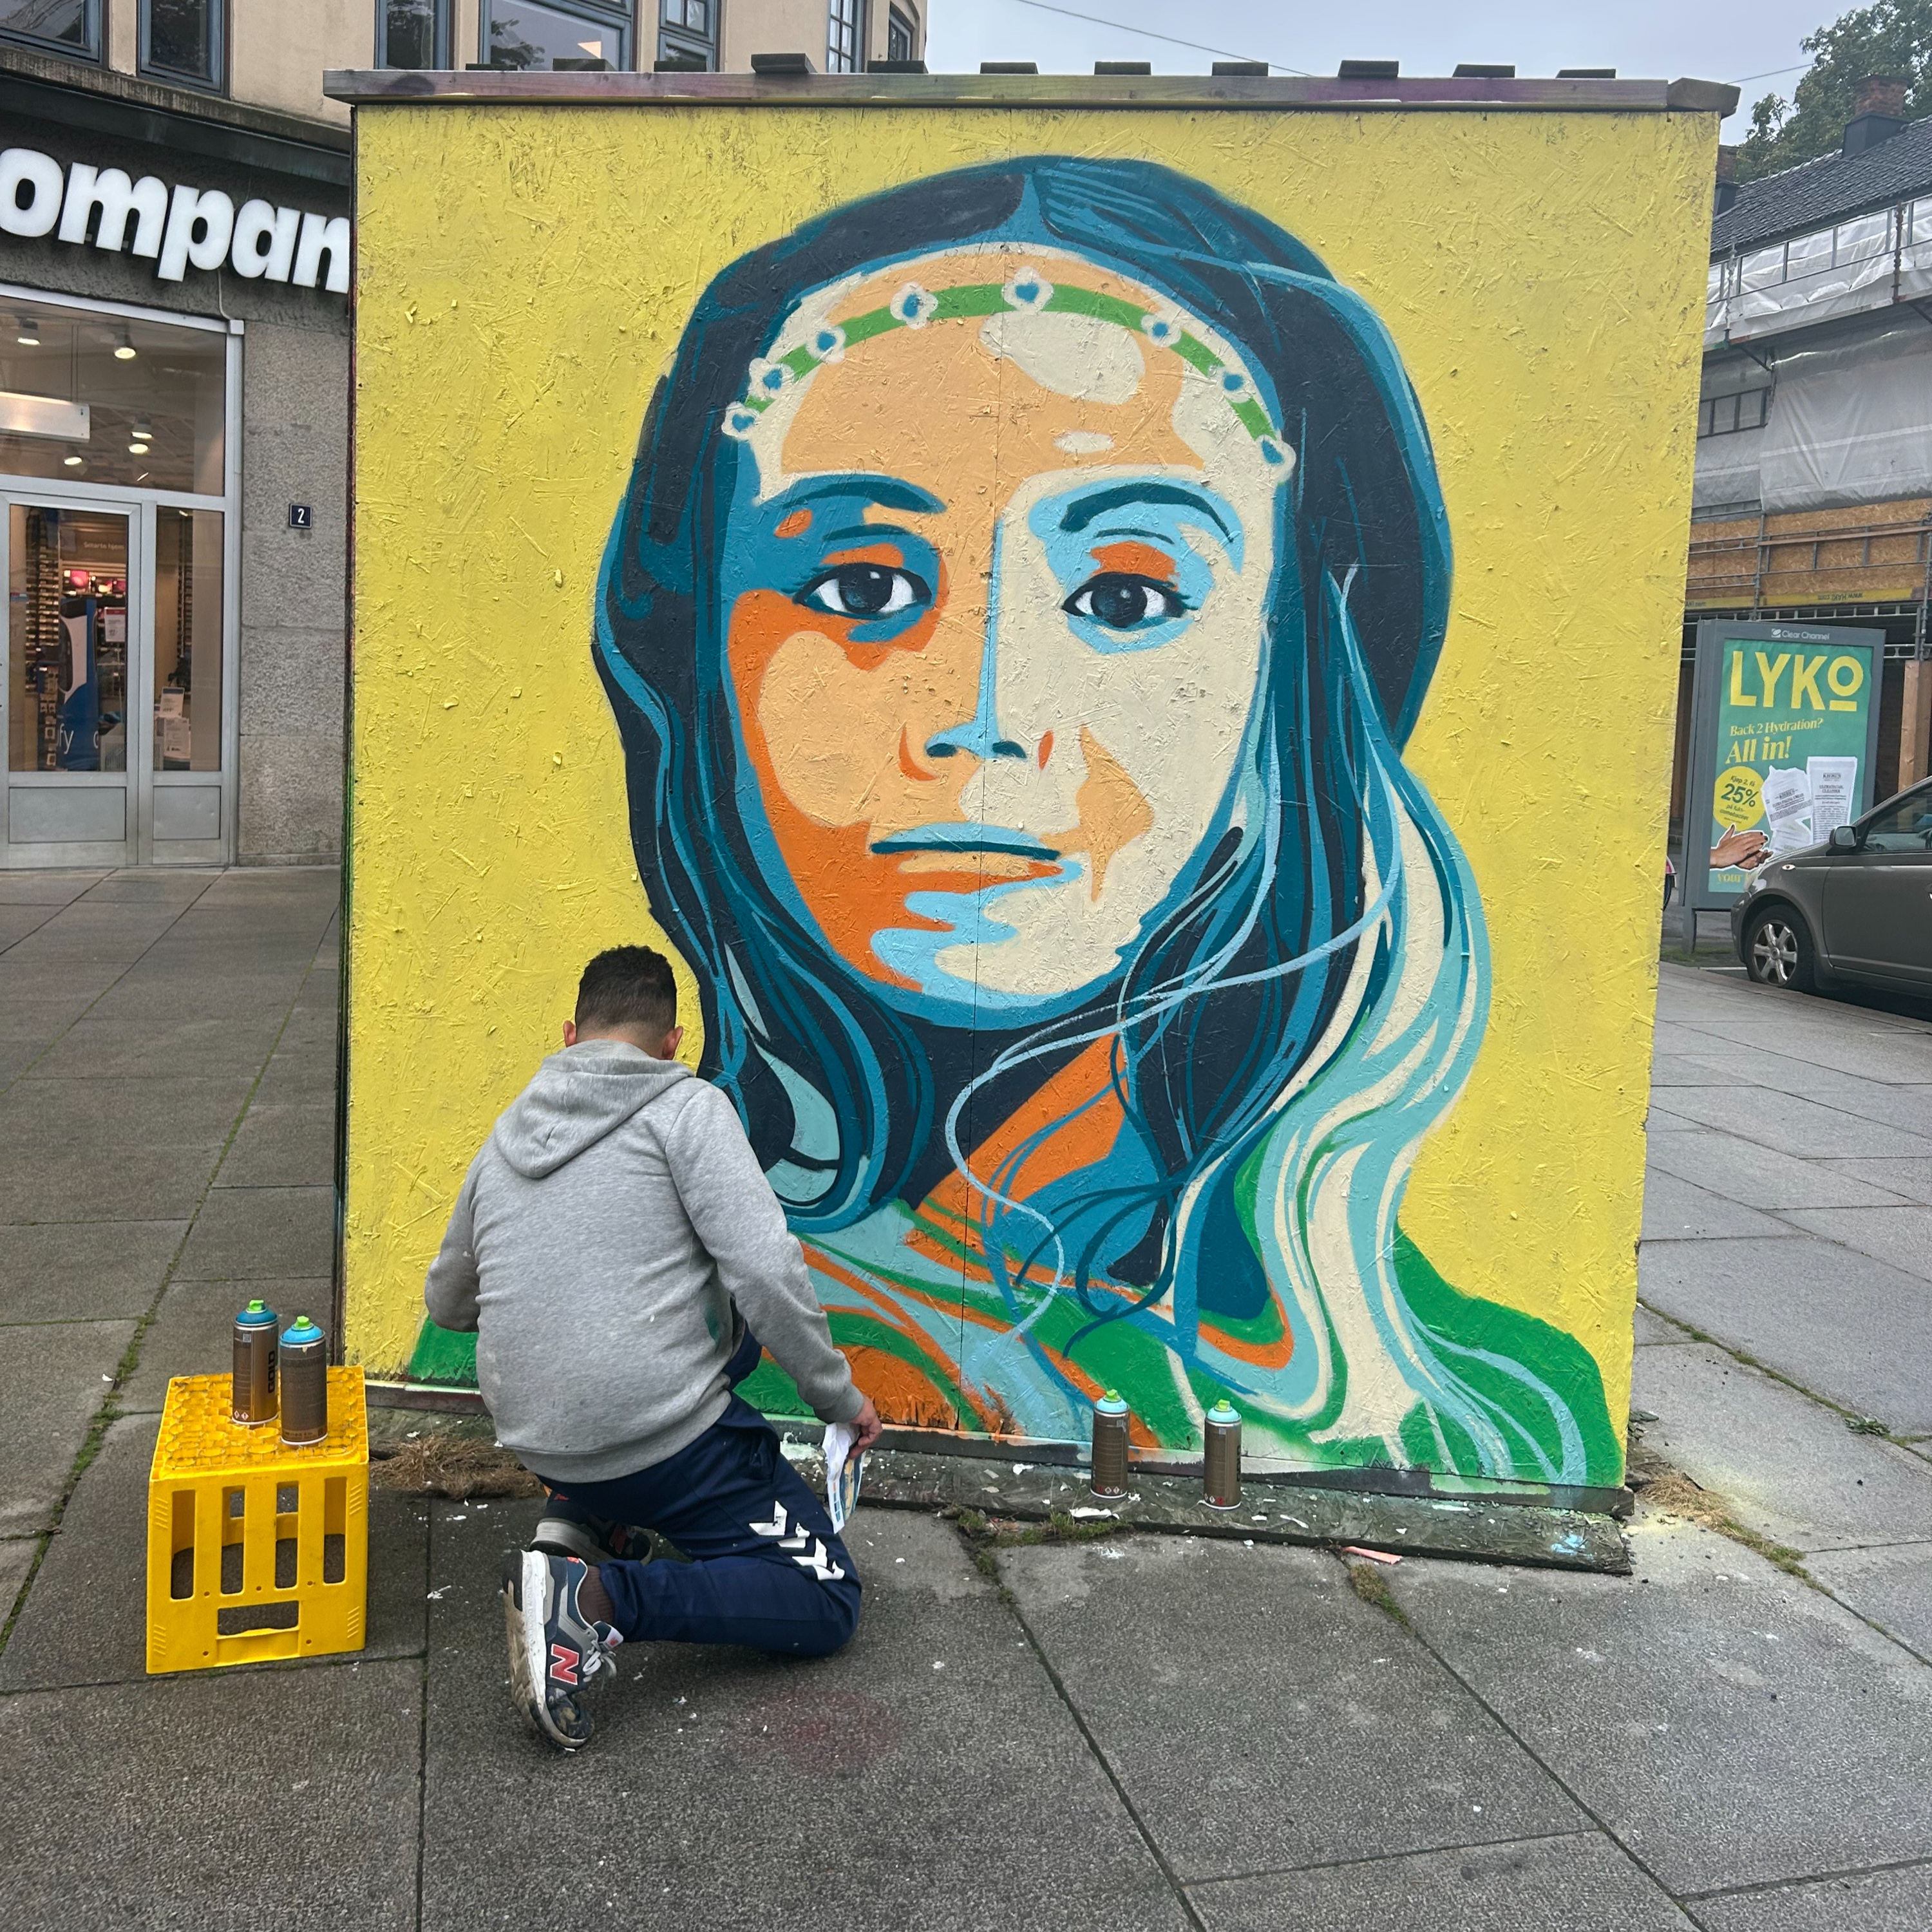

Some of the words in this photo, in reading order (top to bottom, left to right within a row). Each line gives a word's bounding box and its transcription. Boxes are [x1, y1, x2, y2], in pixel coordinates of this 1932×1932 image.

[298, 508, 305, 524] 2
[1782, 630, 1800, 638] Clear
[1801, 632, 1830, 640] Channel
[1730, 650, 1863, 712] LYKO
[1730, 724, 1755, 736] Back
[1756, 723, 1763, 734] 2
[1765, 717, 1824, 734] Hydration?
[1725, 739, 1757, 764] All
[1762, 735, 1792, 761] in!
[1721, 783, 1759, 807] 25%
[550, 1643, 579, 1685] N
